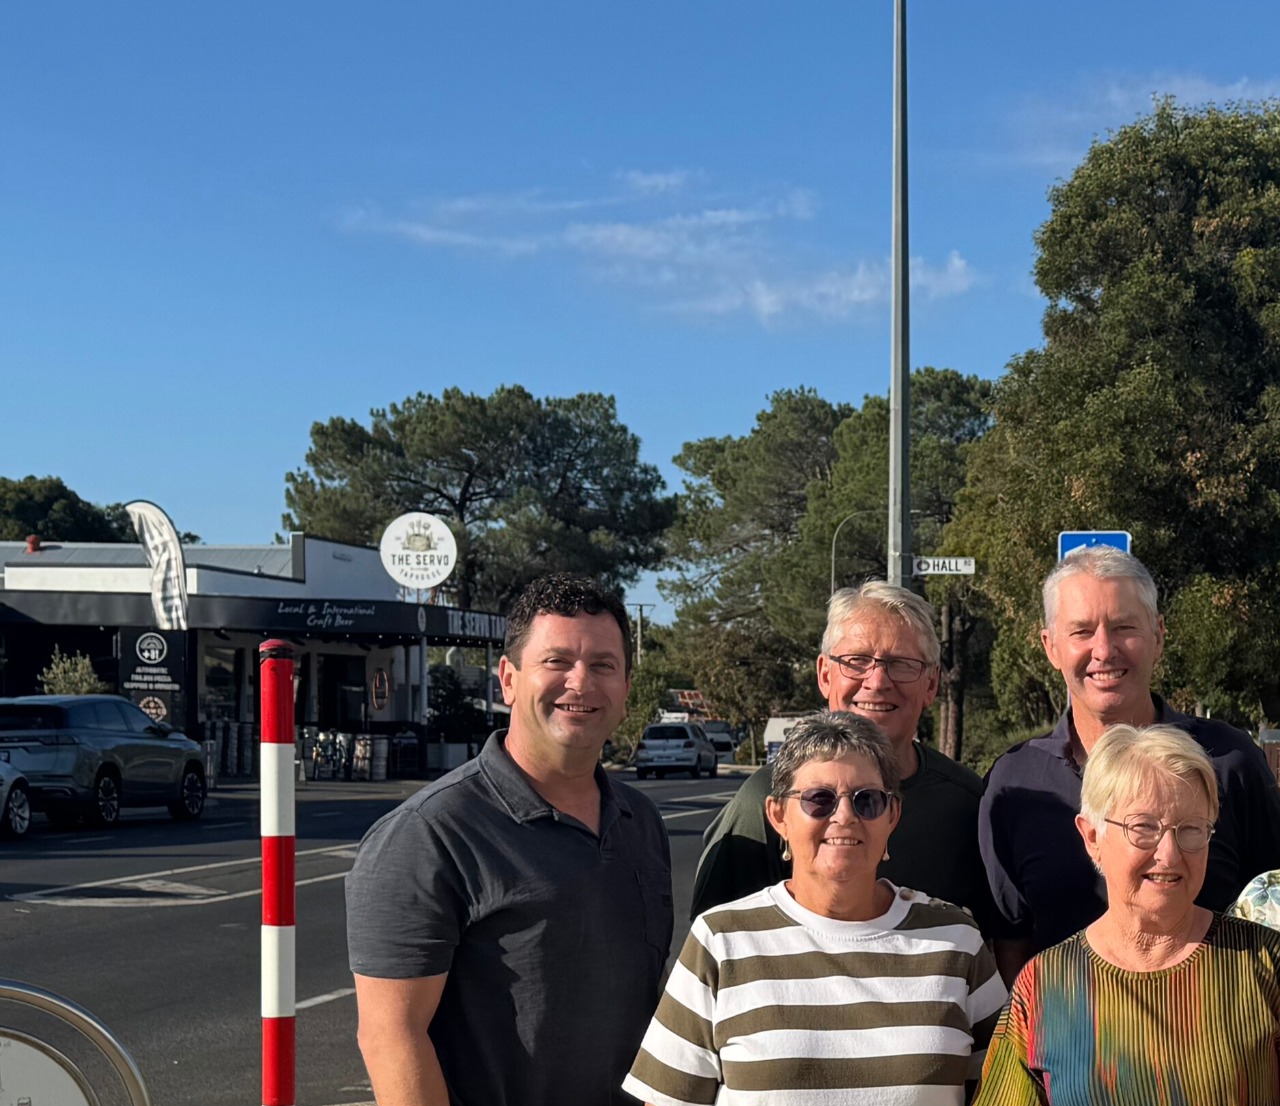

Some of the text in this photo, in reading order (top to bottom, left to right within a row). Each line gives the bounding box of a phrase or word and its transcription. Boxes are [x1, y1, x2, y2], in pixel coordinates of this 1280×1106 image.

[391, 553, 449, 566] THE SERVO
[932, 559, 962, 572] HALL
[277, 601, 305, 614] Local
[322, 601, 376, 615] International
[306, 614, 355, 628] Craft Beer
[446, 609, 464, 636] THE
